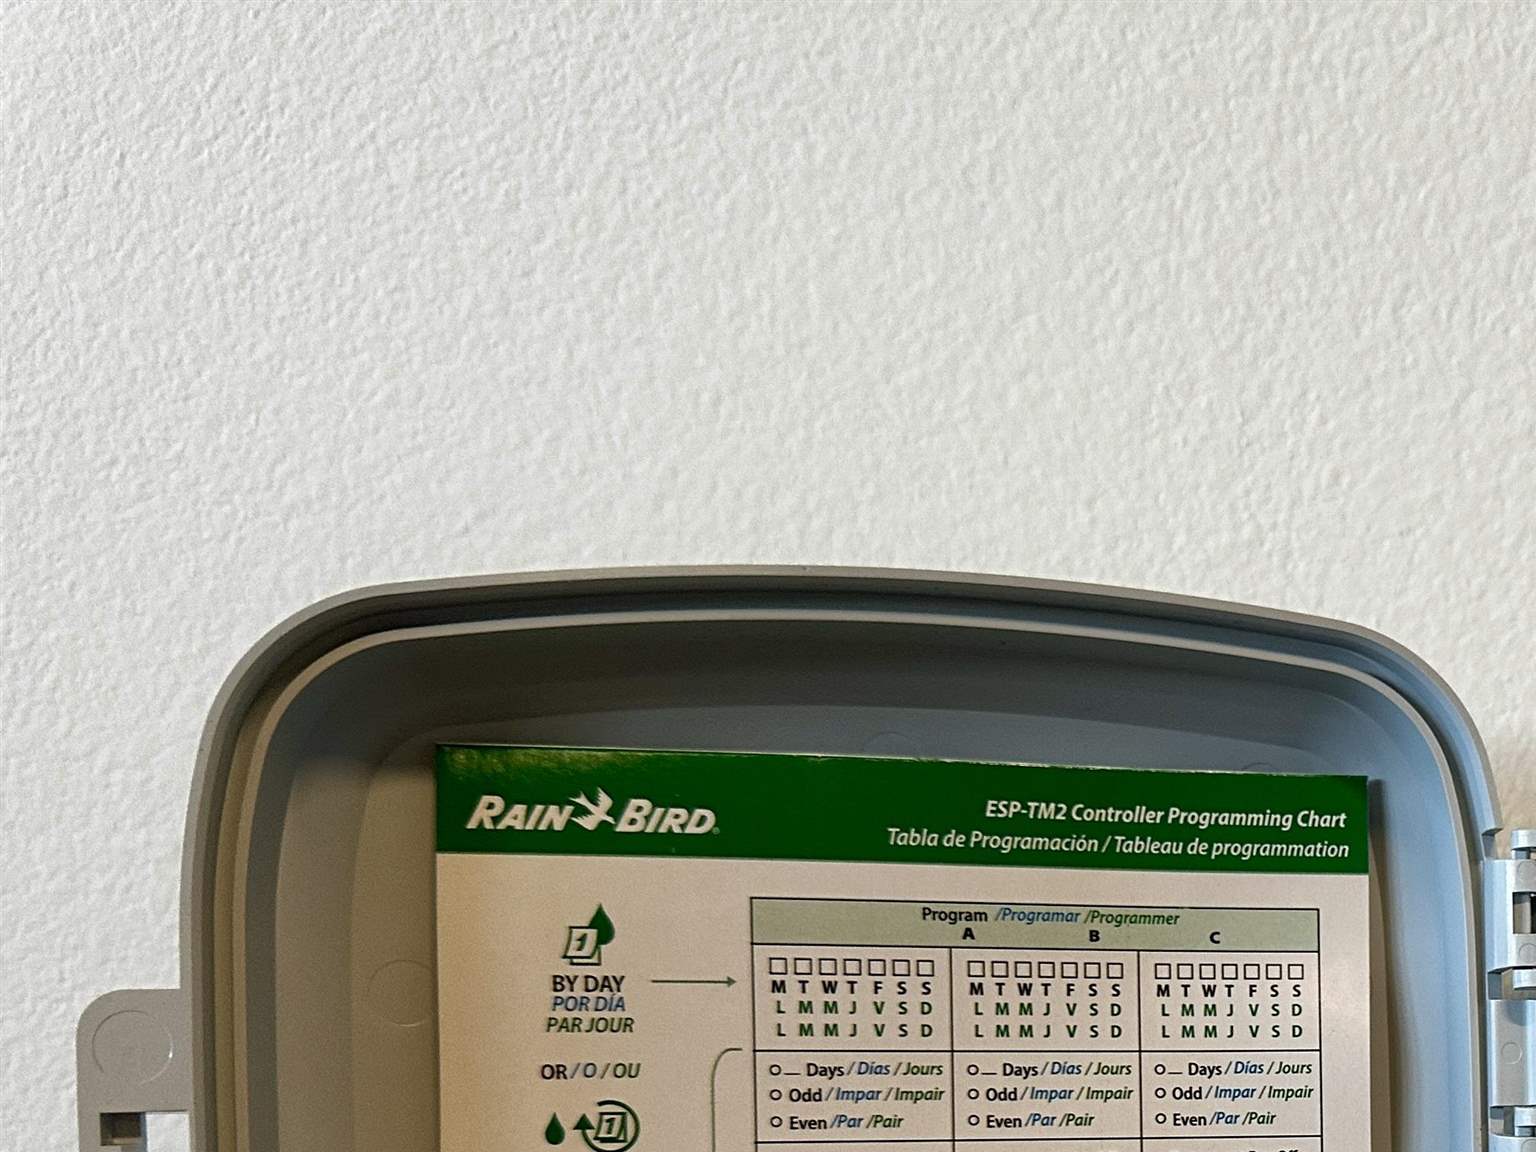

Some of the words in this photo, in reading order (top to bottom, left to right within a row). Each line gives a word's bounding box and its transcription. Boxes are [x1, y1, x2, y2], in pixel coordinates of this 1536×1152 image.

[985, 800, 1068, 822] ESP-TM2
[1071, 803, 1166, 825] Controller
[1168, 806, 1294, 831] Programming
[1298, 809, 1347, 829] Chart
[888, 828, 940, 848] Tabla
[943, 829, 966, 849] de
[970, 830, 1099, 856] Programación
[1114, 835, 1184, 856] Tableau
[1188, 836, 1209, 857] de
[1212, 838, 1351, 861] programmation
[922, 907, 988, 924] Program
[962, 927, 976, 941] A
[1089, 930, 1101, 943] B
[1210, 931, 1221, 944] C
[552, 975, 579, 993] BY
[584, 975, 626, 993] DAY
[552, 996, 590, 1012] POR
[595, 994, 626, 1012] DÍA
[546, 1017, 583, 1034] PAR
[585, 1017, 635, 1034] JOUR
[541, 1064, 568, 1080] OR
[584, 1063, 598, 1078] O
[613, 1062, 641, 1079] OU
[903, 1062, 944, 1076] Jours
[1275, 1061, 1313, 1075] Jours
[895, 1088, 946, 1104] Impair
[1268, 1086, 1314, 1101] Impair
[789, 1116, 828, 1130] Even
[1173, 1113, 1207, 1127] Even
